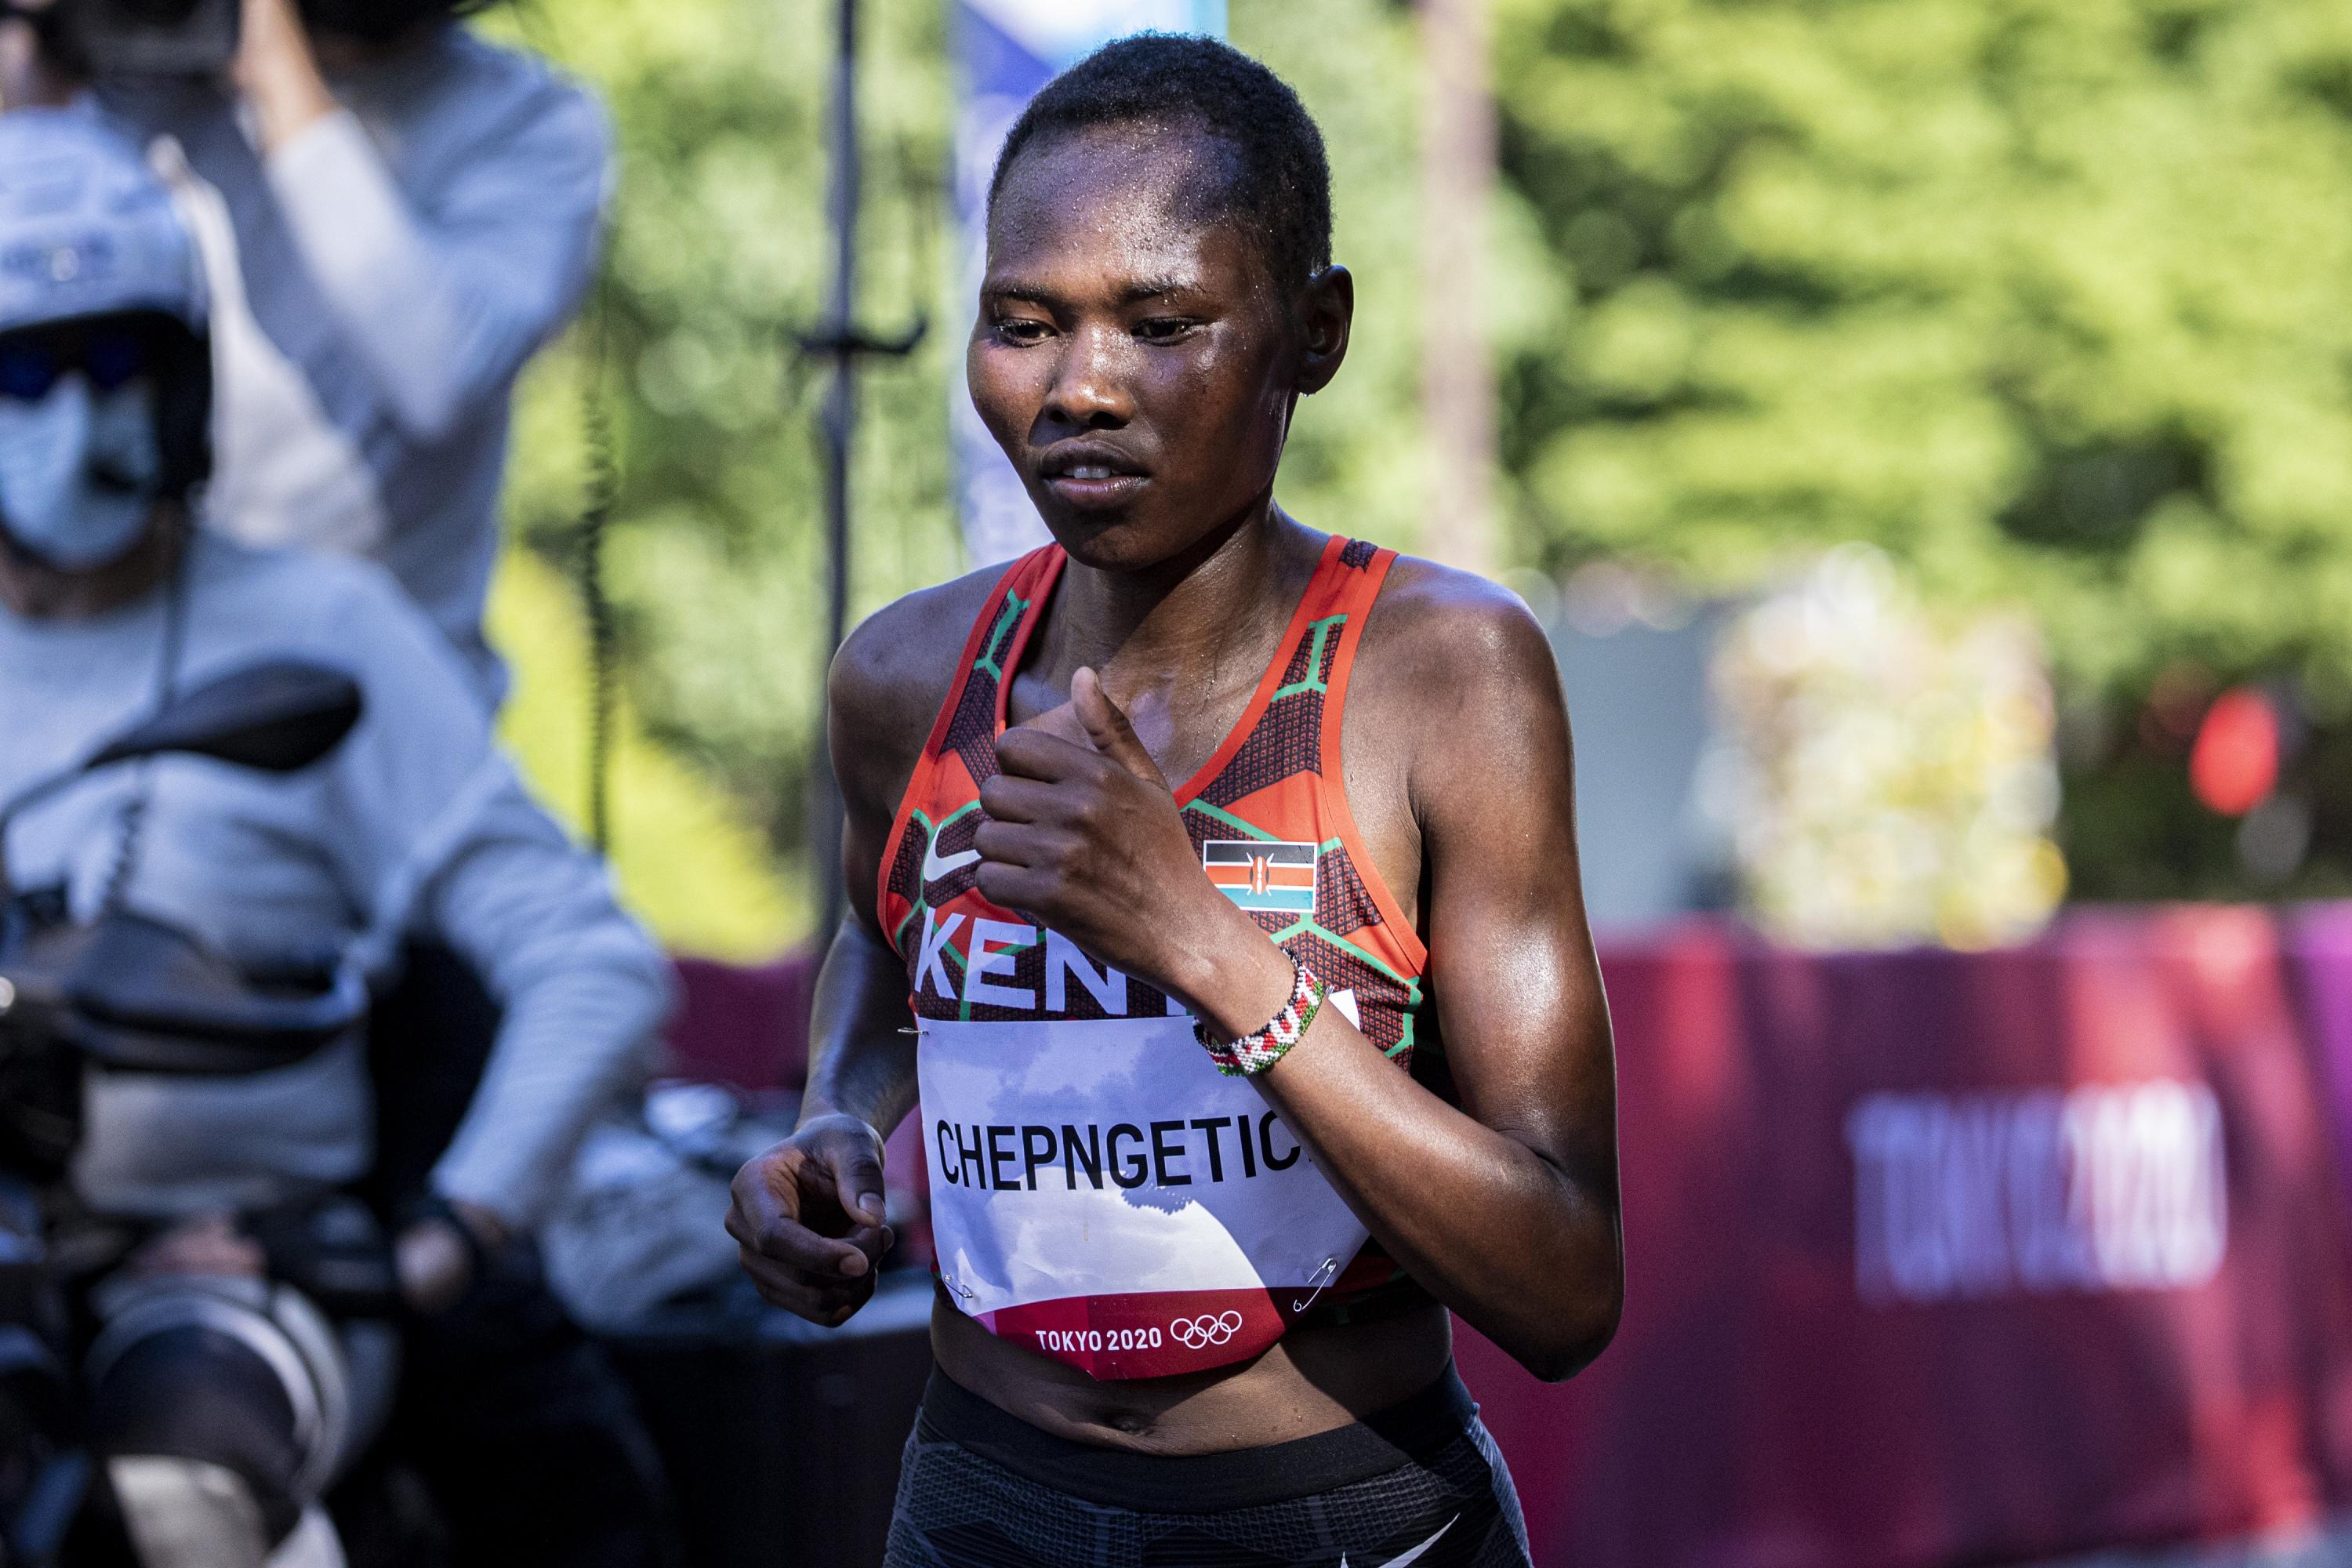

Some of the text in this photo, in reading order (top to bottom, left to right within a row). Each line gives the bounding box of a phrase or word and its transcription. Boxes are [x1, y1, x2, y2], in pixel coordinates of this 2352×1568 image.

[914, 906, 1187, 1016] KEN
[936, 1109, 1312, 1191] CHEPNGETIC
[1035, 1327, 1162, 1352] TOKYO 2020
